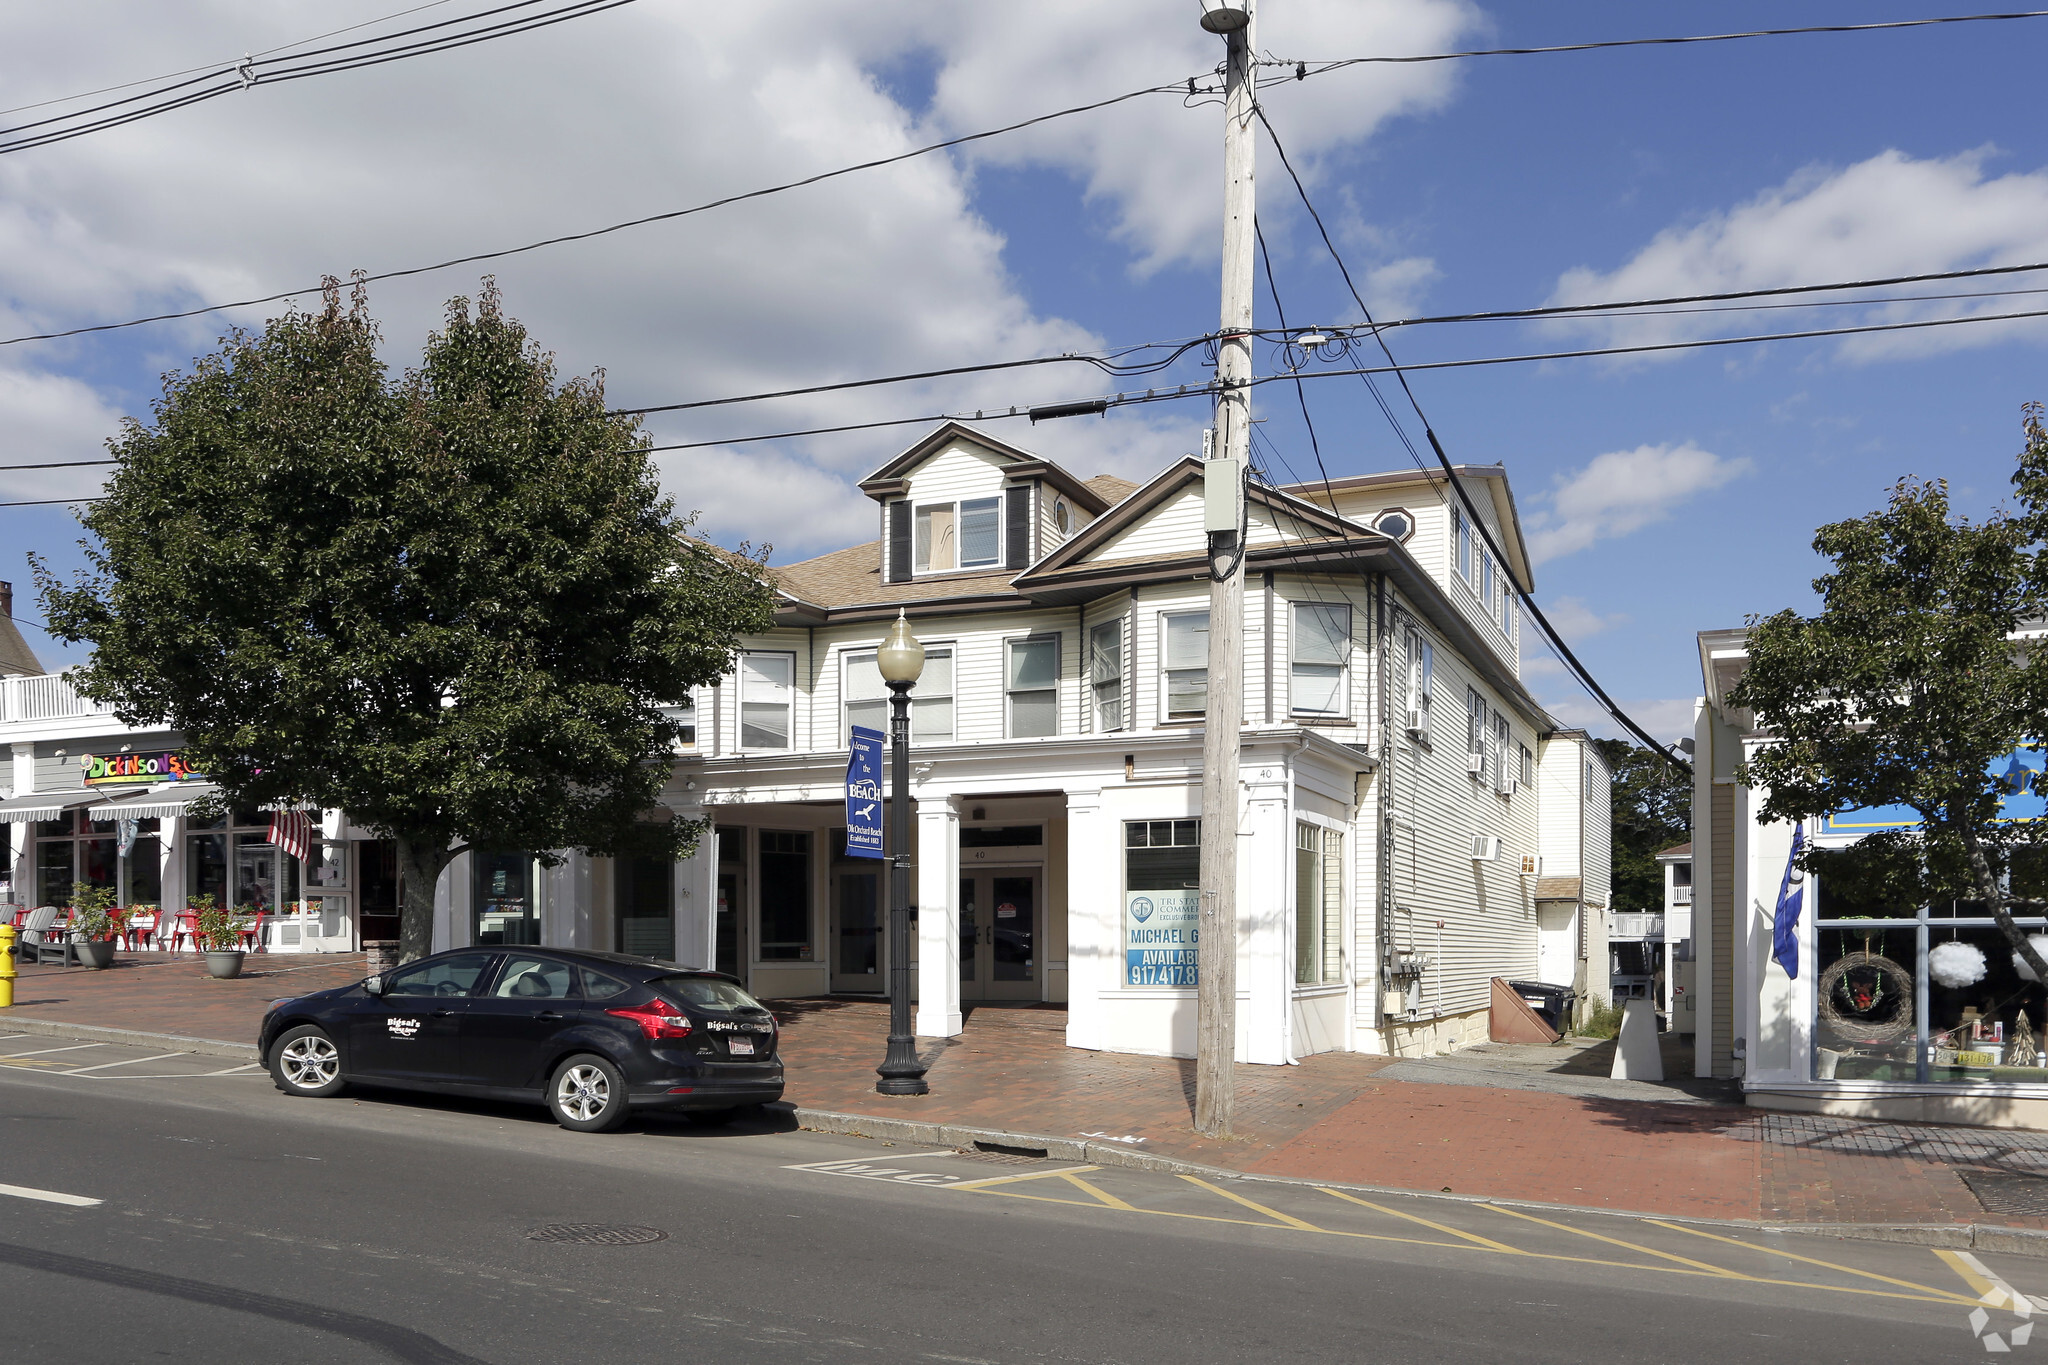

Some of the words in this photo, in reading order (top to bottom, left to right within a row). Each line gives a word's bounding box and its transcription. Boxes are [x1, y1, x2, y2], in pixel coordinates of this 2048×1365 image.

[859, 753, 865, 762] to
[863, 764, 871, 774] the
[1260, 769, 1272, 778] 40
[849, 783, 881, 802] BEACH
[975, 851, 985, 859] 40
[330, 858, 339, 867] 42
[1131, 929, 1186, 943] MICHAEL
[1191, 929, 1199, 943] G
[1131, 966, 1198, 985] 917.417.8
[387, 1017, 421, 1028] Bigsal's
[706, 1021, 738, 1031] Bigsal's
